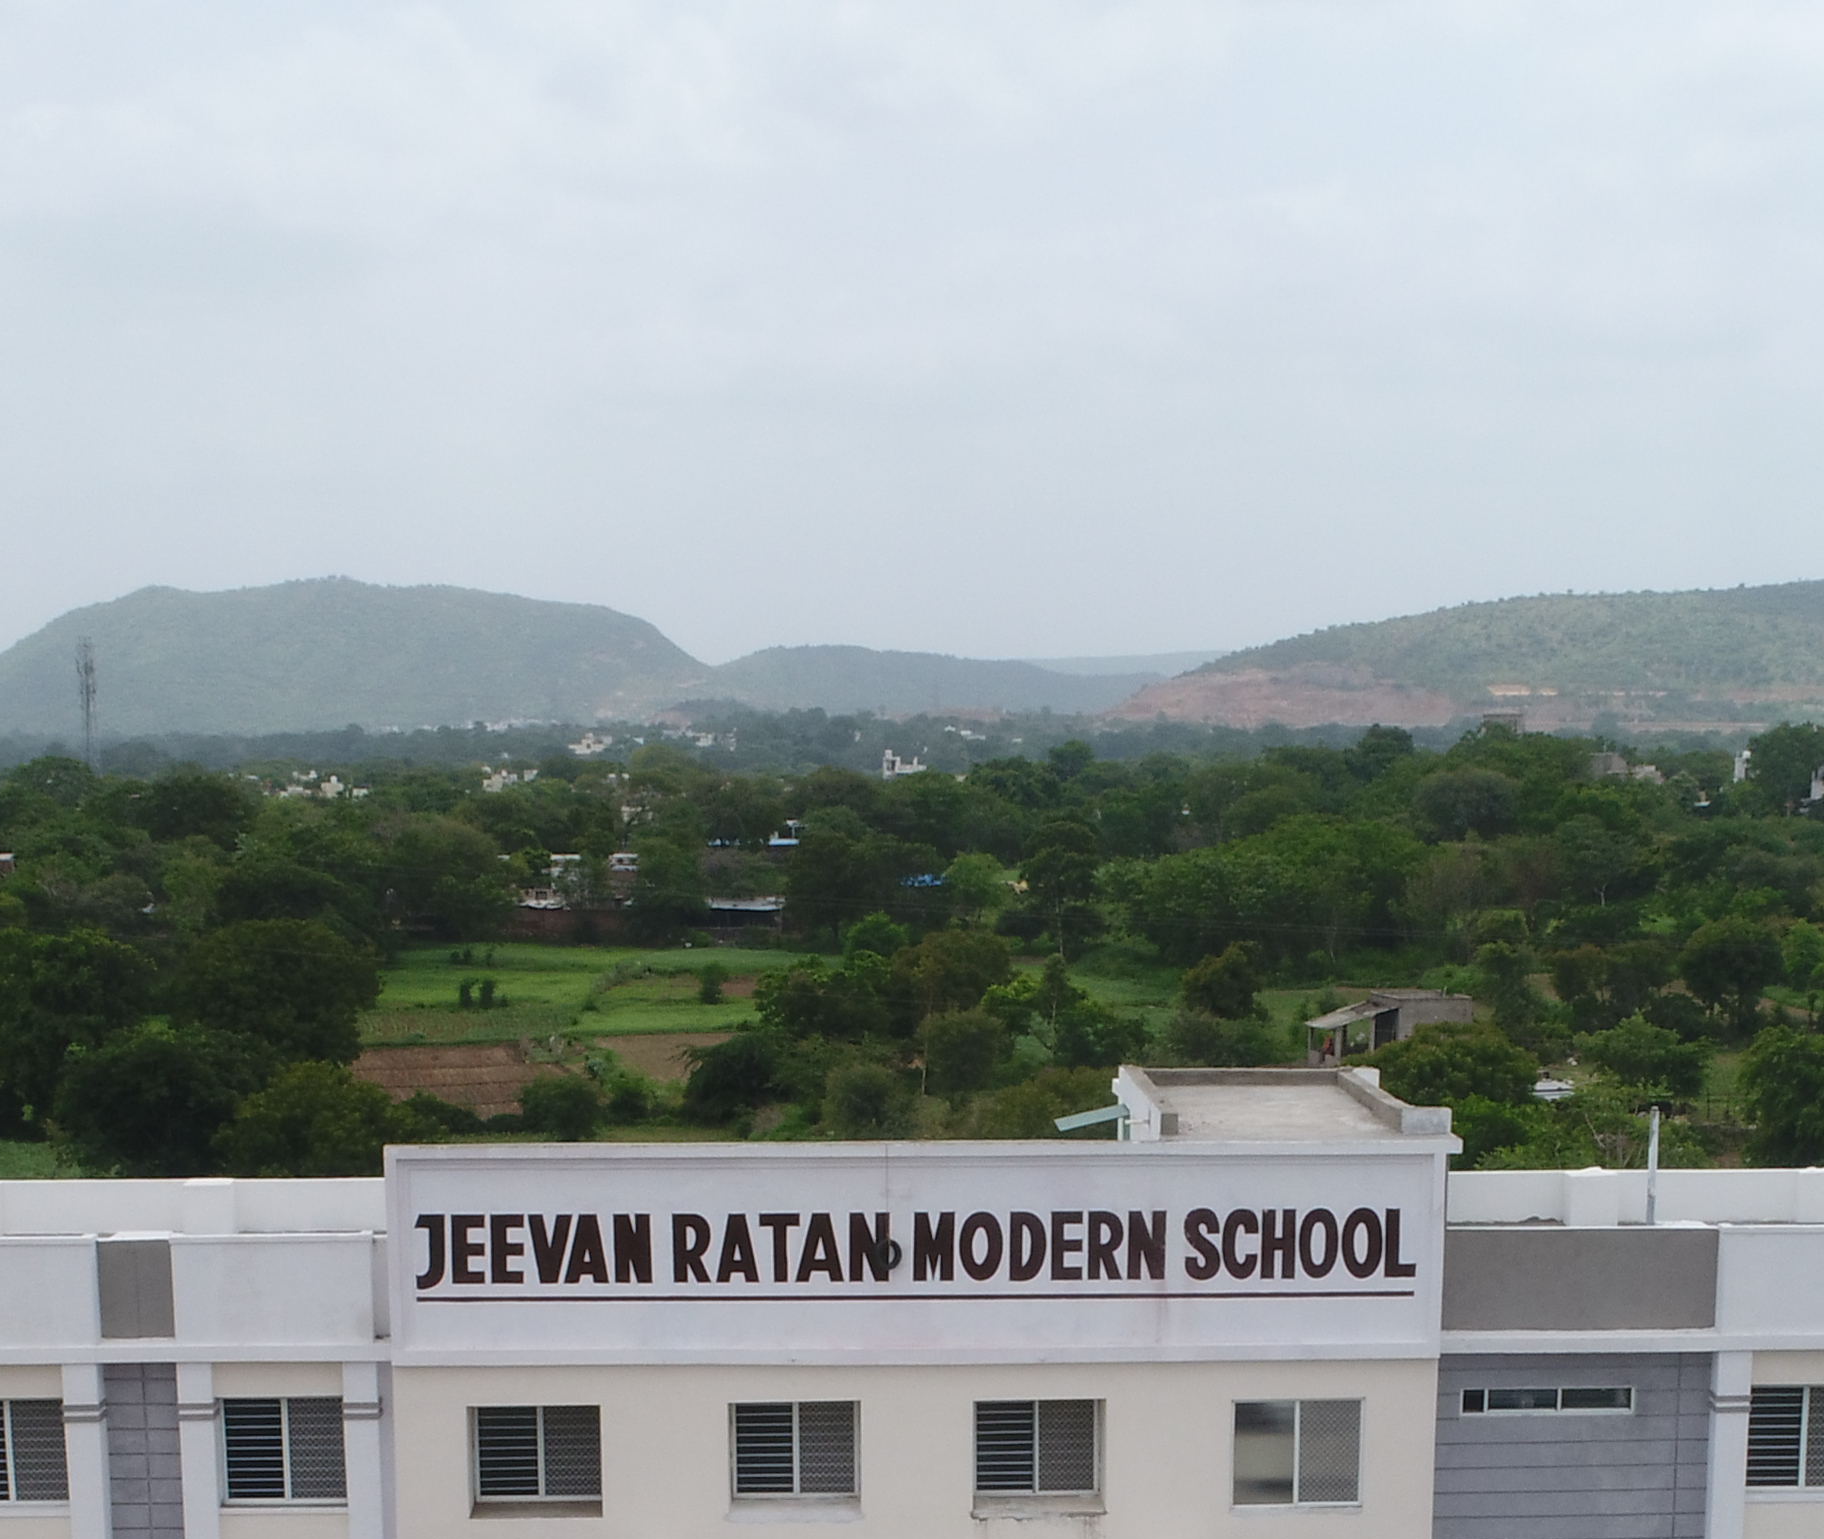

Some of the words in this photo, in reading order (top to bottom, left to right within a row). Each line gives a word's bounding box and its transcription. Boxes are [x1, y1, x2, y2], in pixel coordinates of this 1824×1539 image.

[415, 1212, 653, 1289] JEEVAN
[671, 1212, 891, 1284] RATAN
[912, 1210, 1167, 1282] MODERN
[1183, 1207, 1416, 1280] SCHOOL
